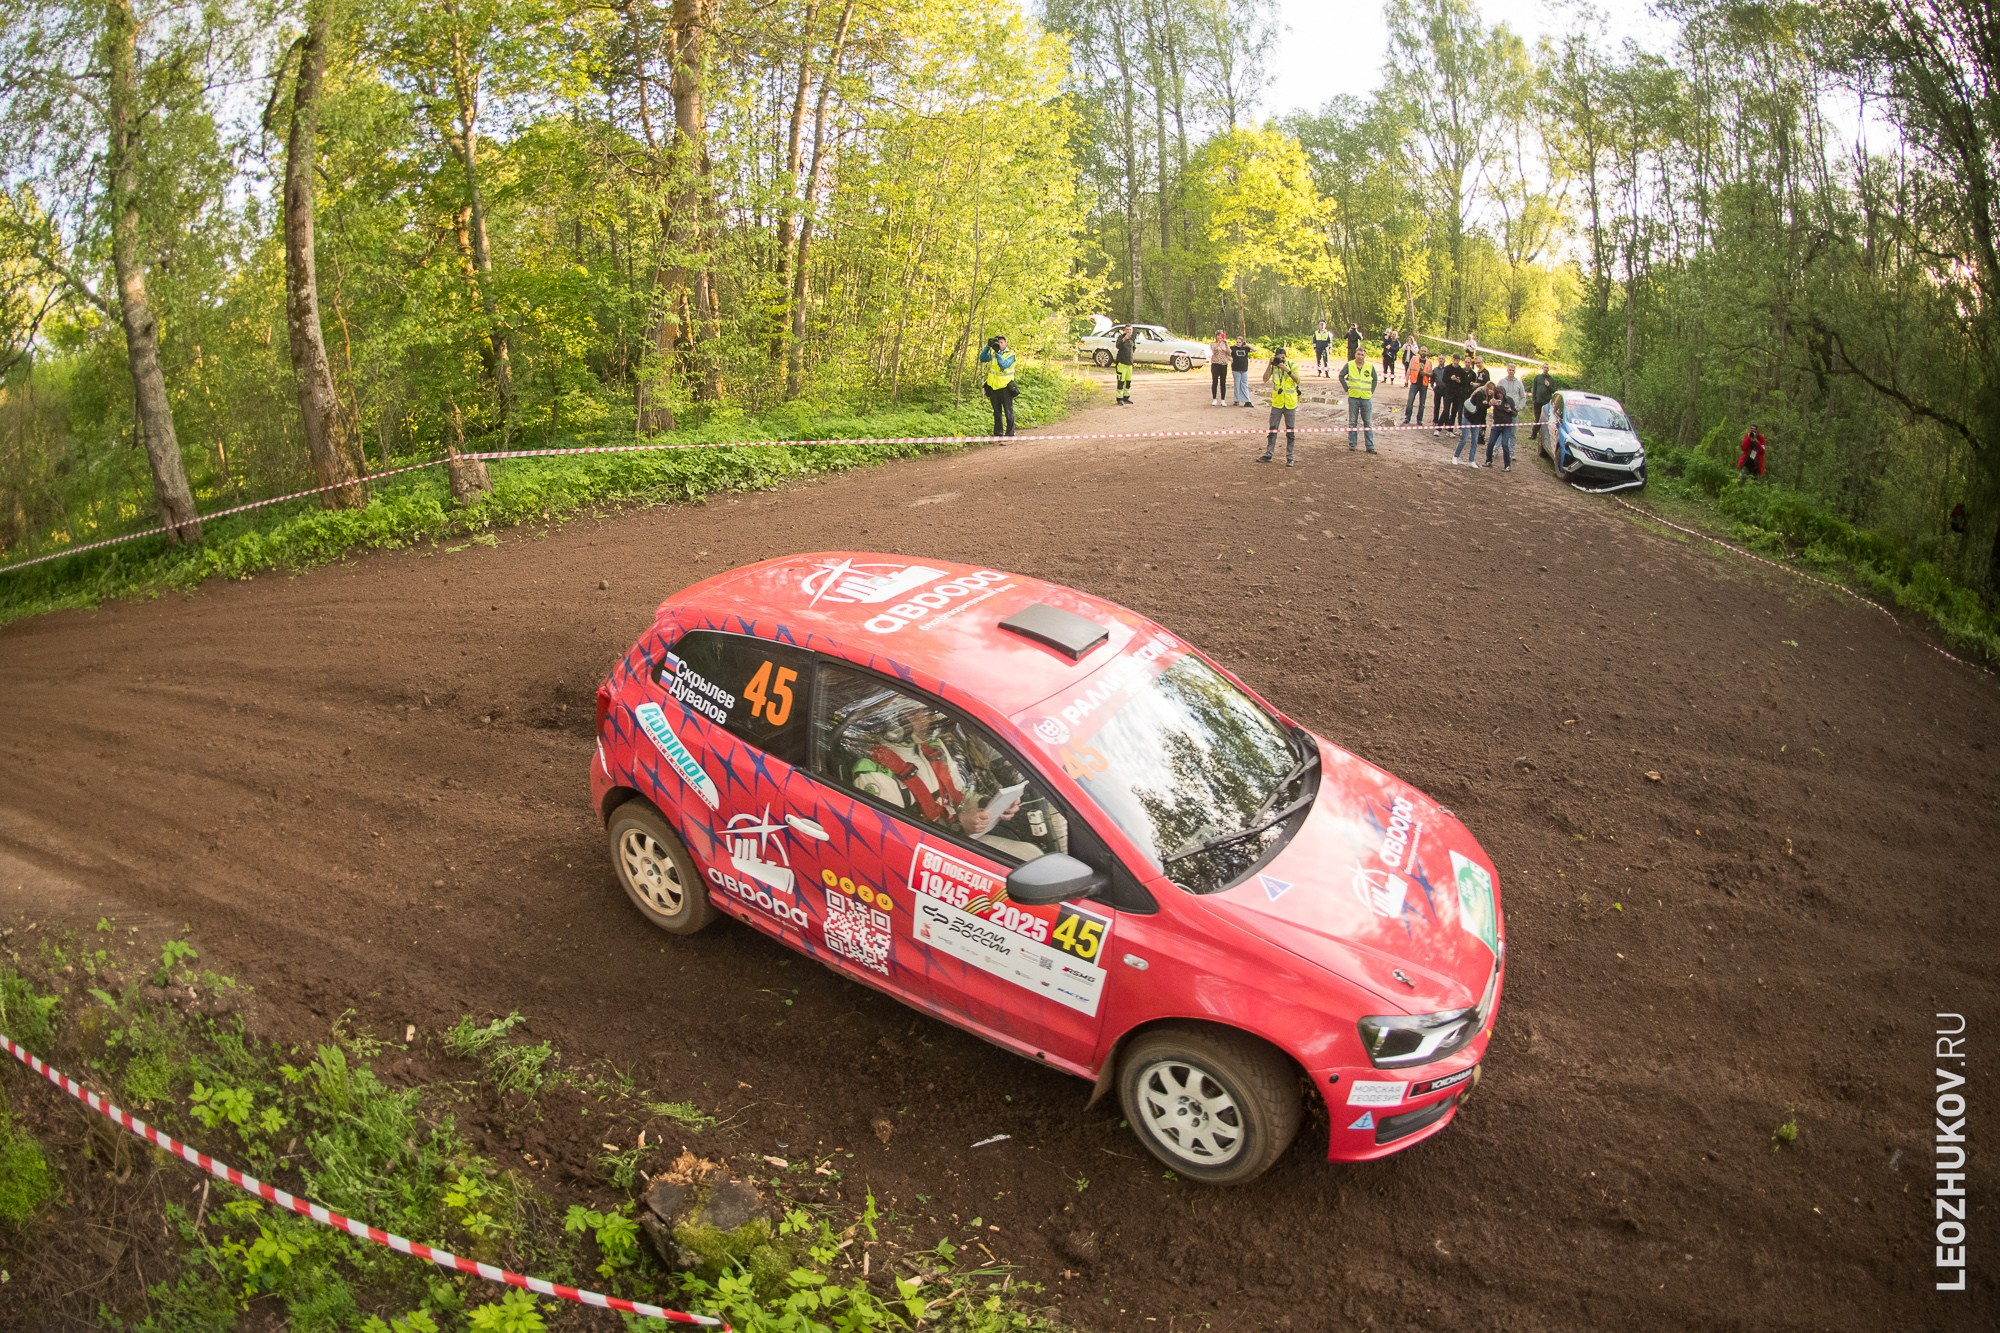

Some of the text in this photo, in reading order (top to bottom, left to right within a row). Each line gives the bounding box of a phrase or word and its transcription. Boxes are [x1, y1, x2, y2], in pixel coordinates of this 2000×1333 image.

[864, 569, 1009, 633] аврора
[669, 677, 727, 725] Дувалов
[675, 660, 735, 709] Скрылев
[743, 660, 798, 727] 45
[1058, 739, 1110, 781] 45
[825, 871, 890, 908] vezu
[922, 852, 994, 894] 80 ПОБЕДА!
[708, 867, 809, 928] аврора
[920, 871, 1050, 943] 1945 2025
[948, 924, 1011, 956] РОССИИ
[953, 916, 1006, 944] РАЛЛИ
[1053, 913, 1105, 959] 45
[1354, 1085, 1402, 1093] МОРСКАЯ
